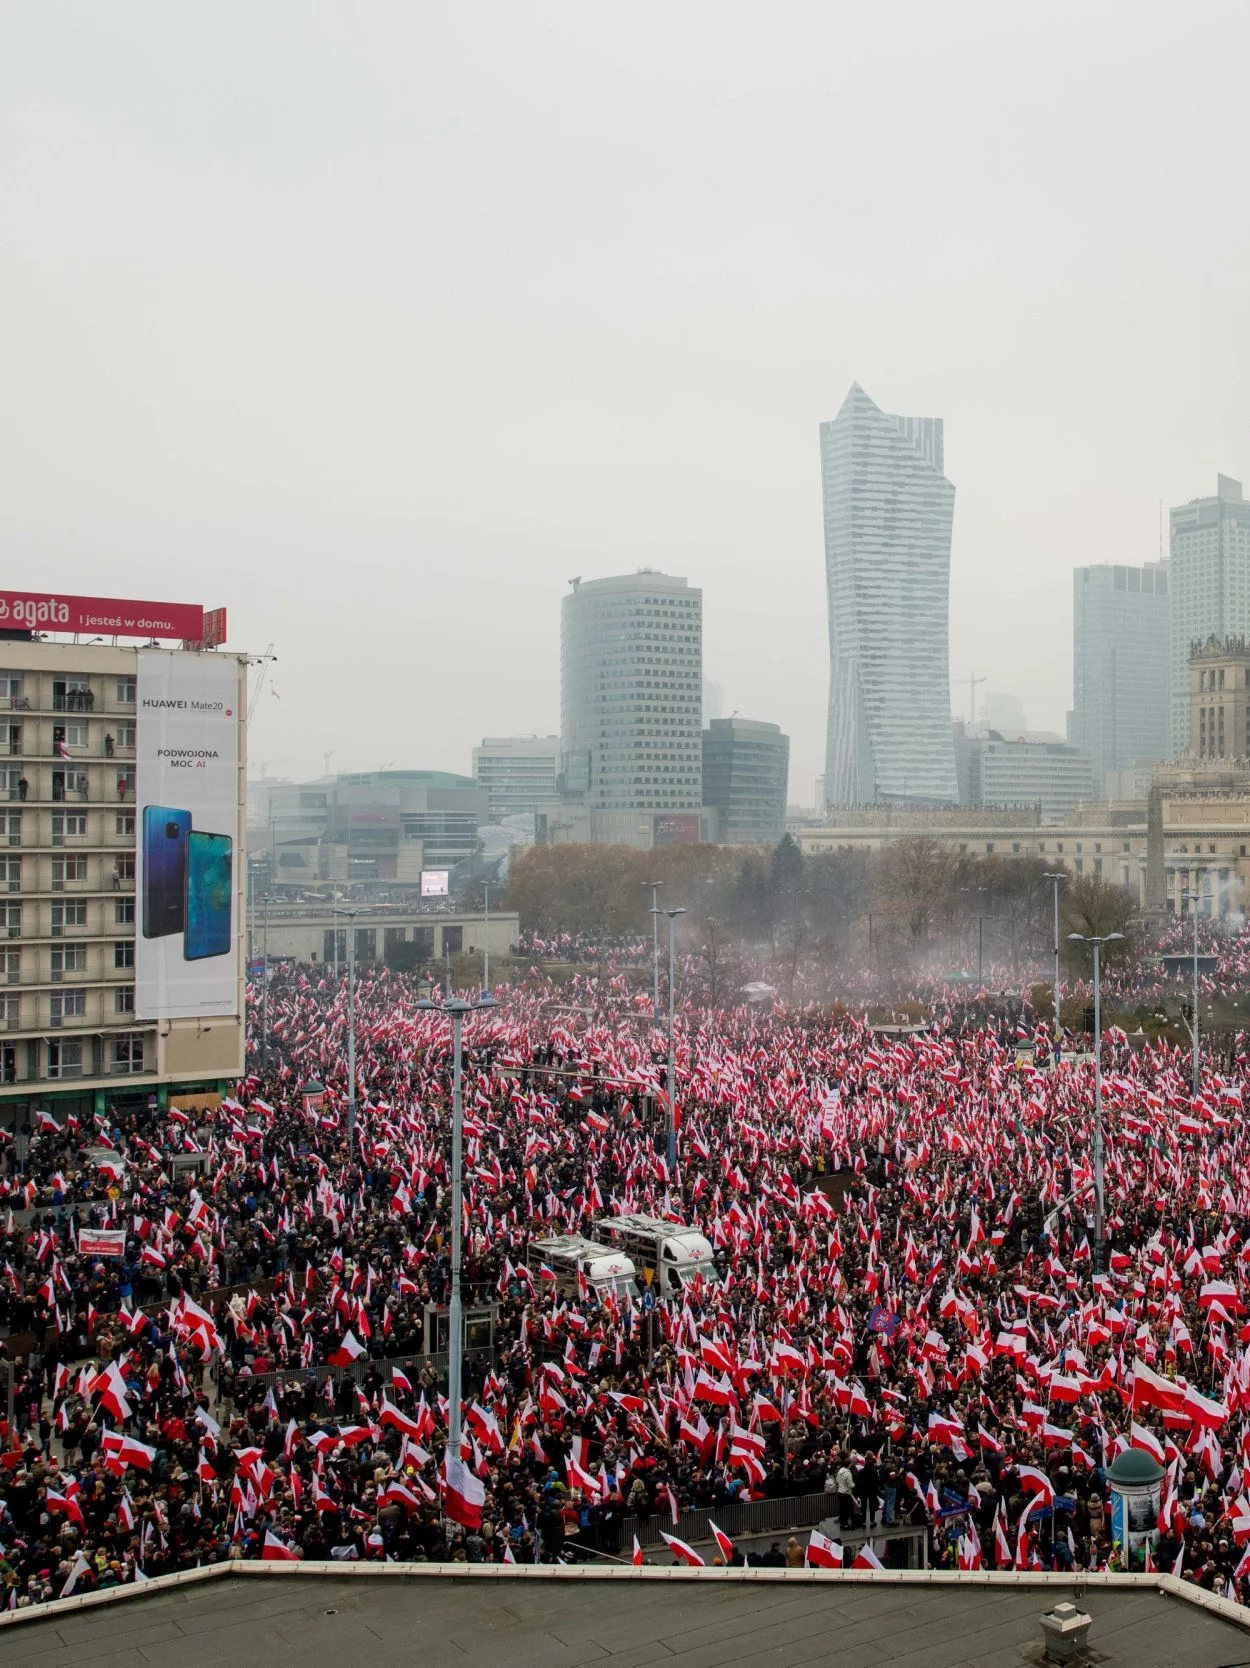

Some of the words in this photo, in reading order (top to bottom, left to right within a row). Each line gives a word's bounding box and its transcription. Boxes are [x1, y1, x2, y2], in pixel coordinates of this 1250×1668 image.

[13, 598, 70, 627] agata
[79, 615, 83, 624] I
[85, 614, 122, 627] jesteś
[125, 617, 136, 627] w
[138, 618, 175, 630] domu.
[142, 699, 187, 709] HUAWEI
[191, 701, 223, 710] Mate20
[157, 749, 219, 758] PODWOJONA
[170, 760, 193, 768] MOC
